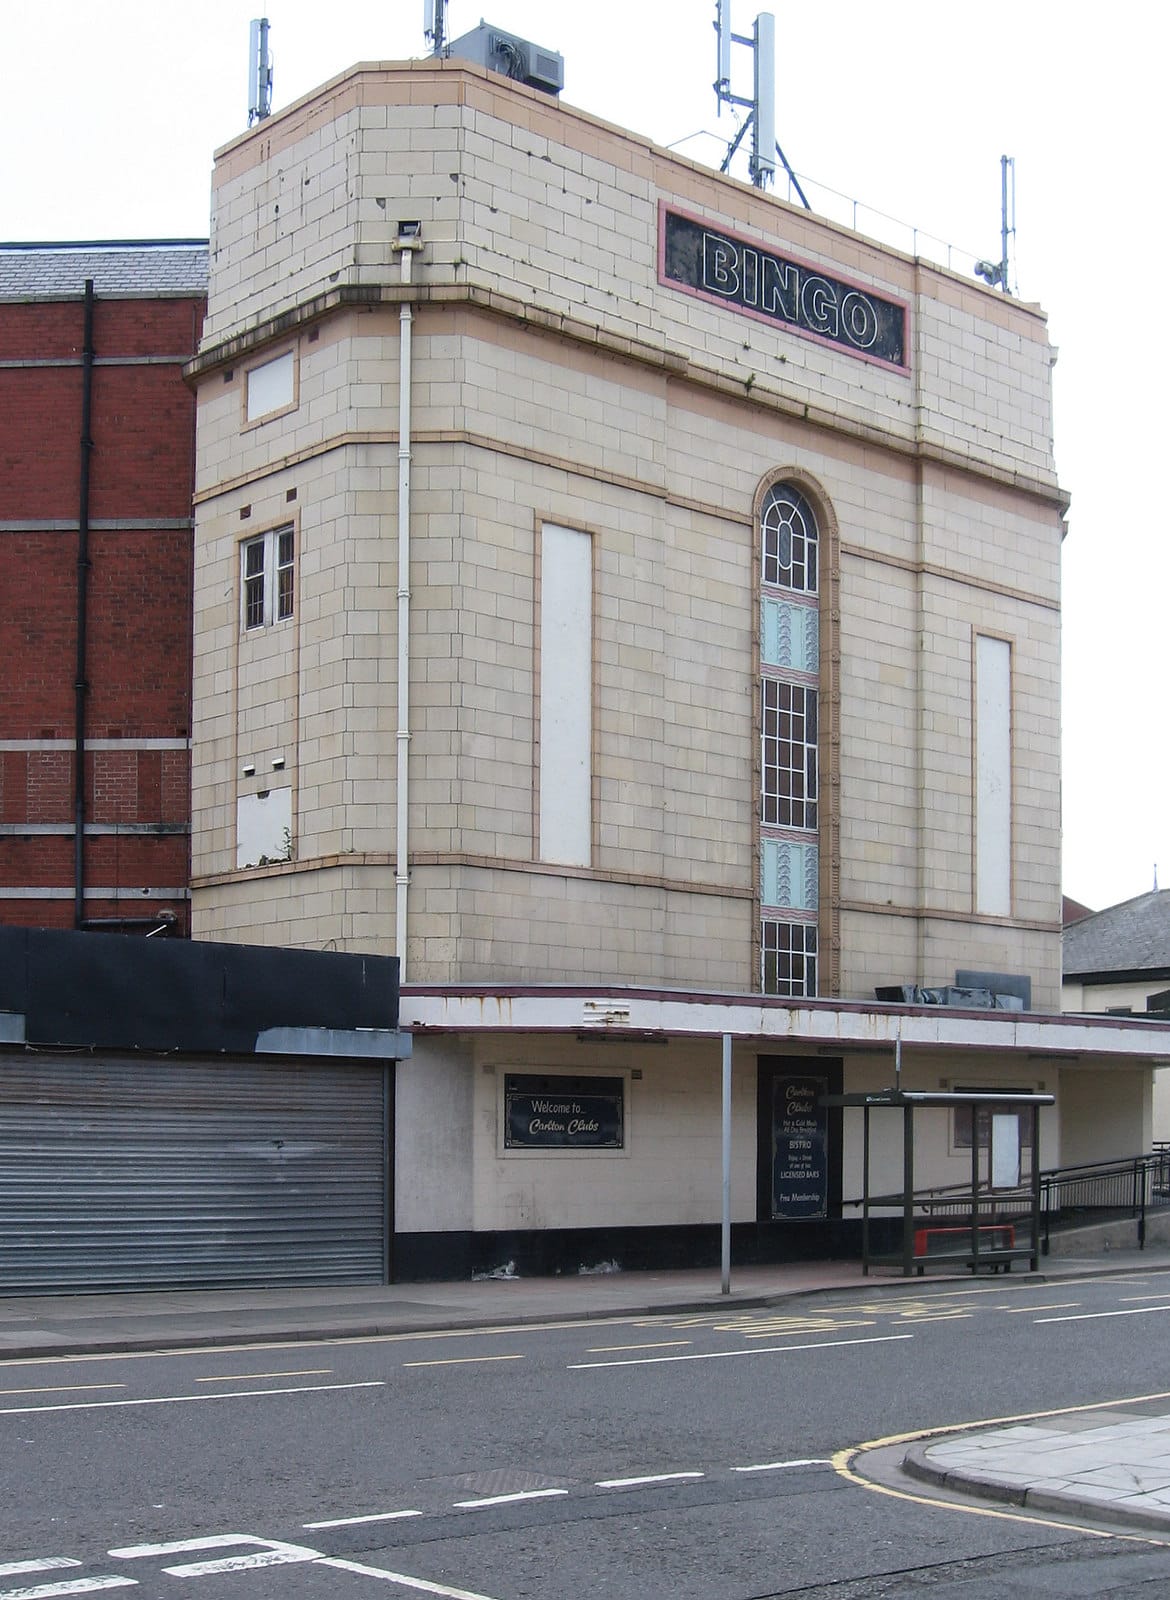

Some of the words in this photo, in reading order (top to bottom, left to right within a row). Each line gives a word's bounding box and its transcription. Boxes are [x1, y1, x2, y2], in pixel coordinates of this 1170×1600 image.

[703, 232, 878, 348] BINGO
[531, 1100, 570, 1114] Welcome
[529, 1118, 565, 1135] Carlton
[567, 1118, 600, 1135] Clubs
[789, 1140, 812, 1149] BISTRO
[780, 1170, 806, 1179] LICENSED
[806, 1170, 820, 1178] BARS
